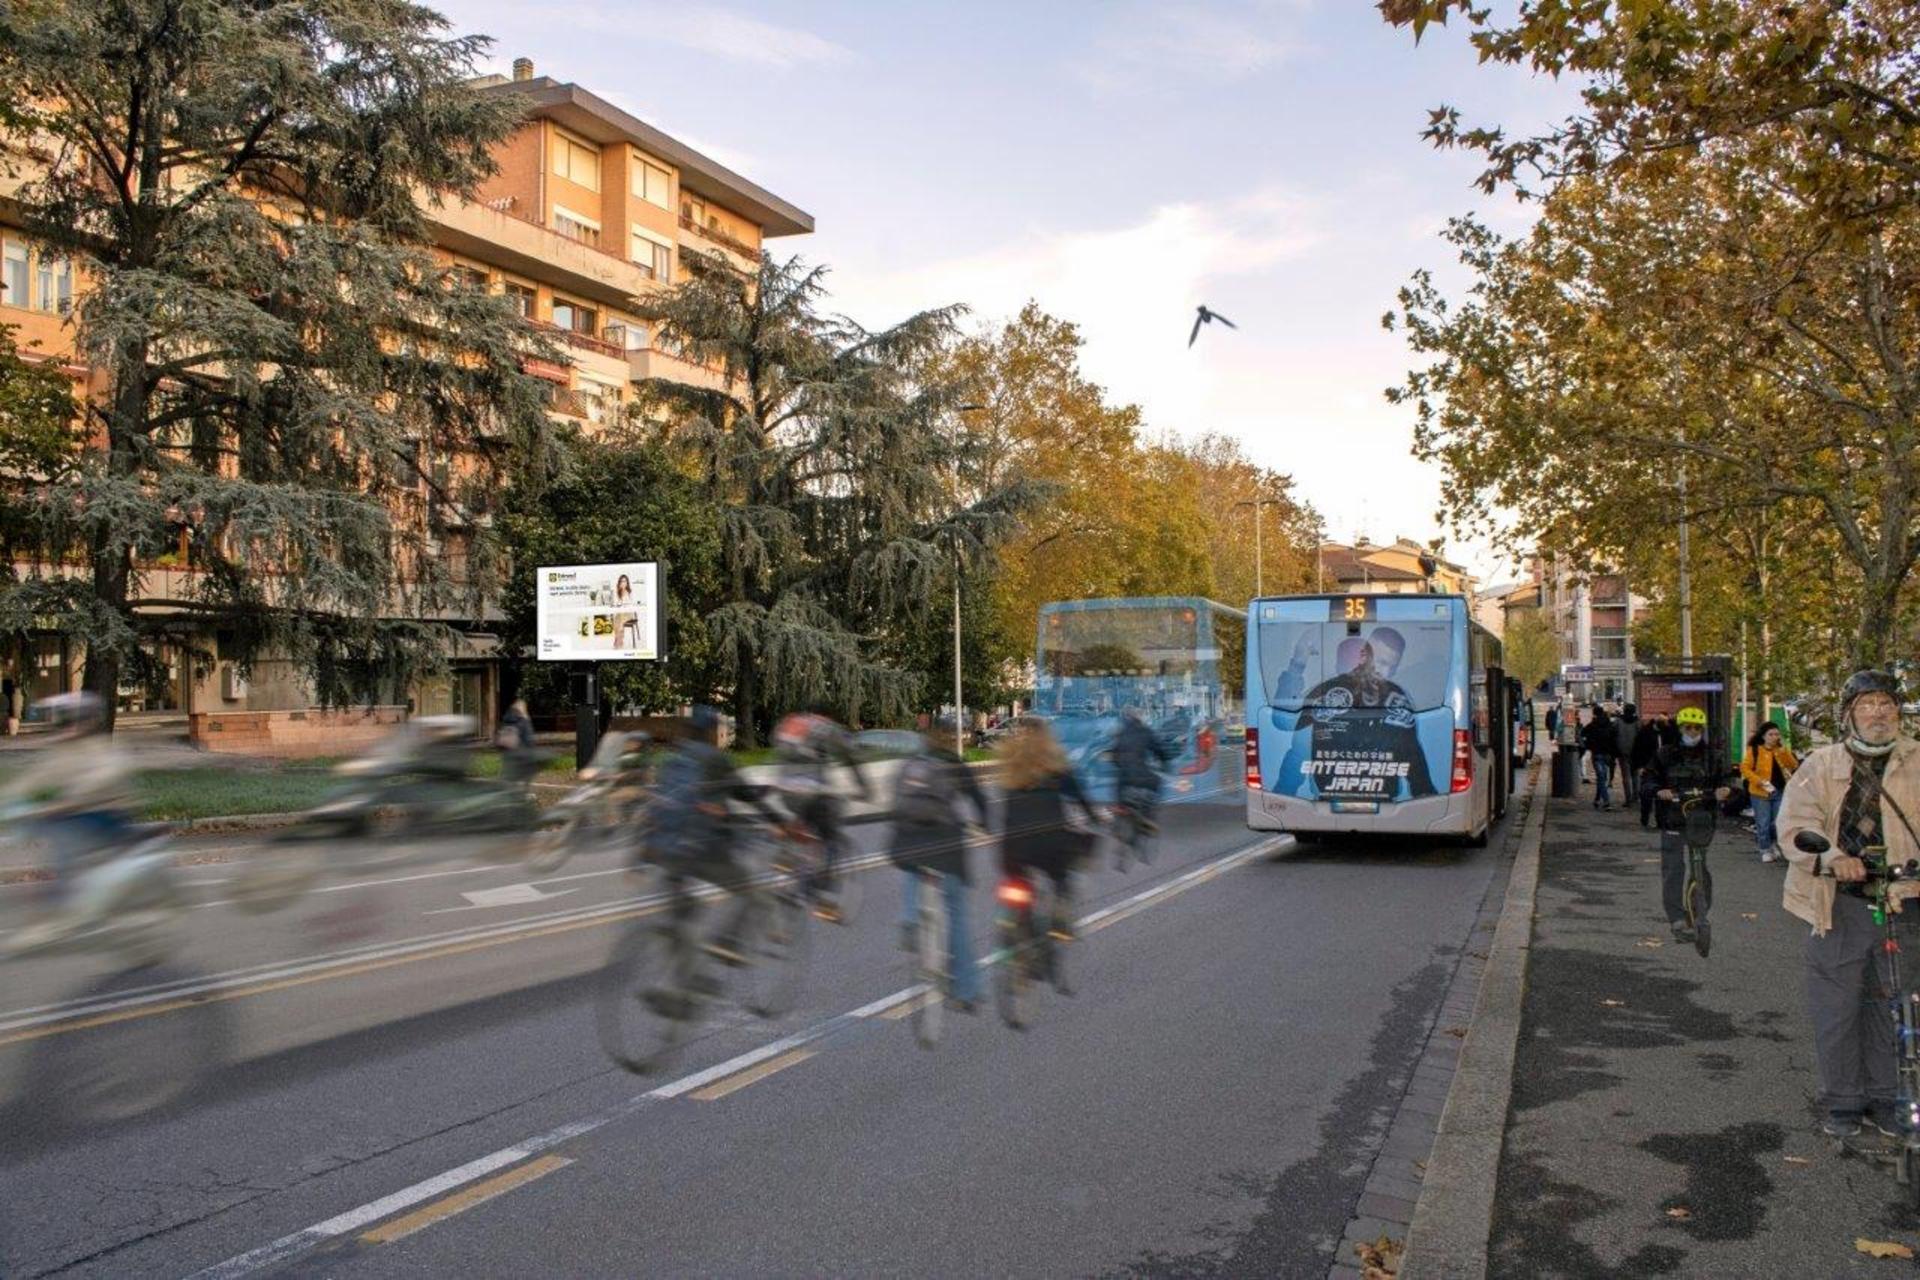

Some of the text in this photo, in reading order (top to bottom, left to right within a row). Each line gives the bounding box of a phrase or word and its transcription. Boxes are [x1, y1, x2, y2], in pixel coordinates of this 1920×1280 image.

[1344, 598, 1366, 619] 35
[1301, 761, 1410, 776] ENTERPRISE
[1324, 777, 1384, 791] JAPAN
